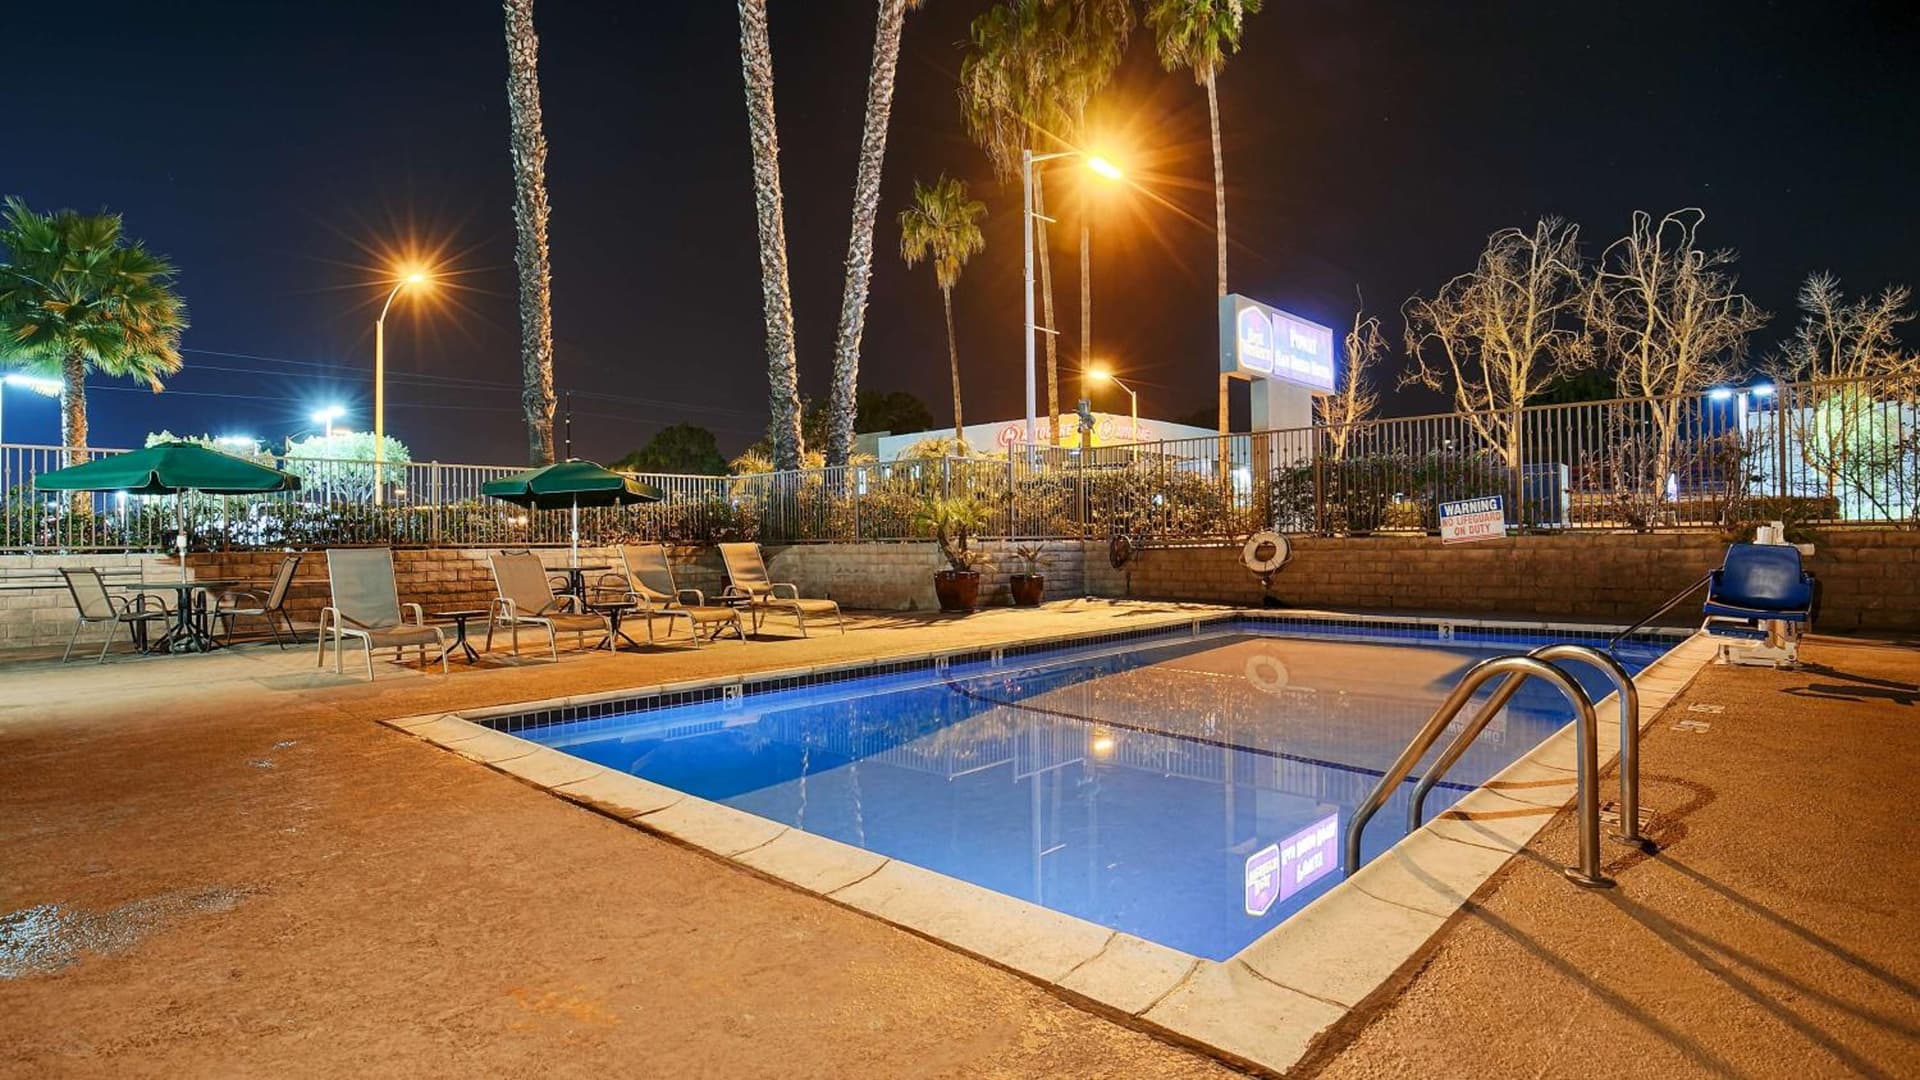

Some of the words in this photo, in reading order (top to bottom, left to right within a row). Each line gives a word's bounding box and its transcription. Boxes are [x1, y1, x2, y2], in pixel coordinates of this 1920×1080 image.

[1444, 499, 1498, 516] WARNING
[1442, 517, 1454, 527] NO
[1456, 511, 1501, 526] LIFEGUARD
[1454, 526, 1466, 536] ON
[1469, 522, 1490, 534] DUTY
